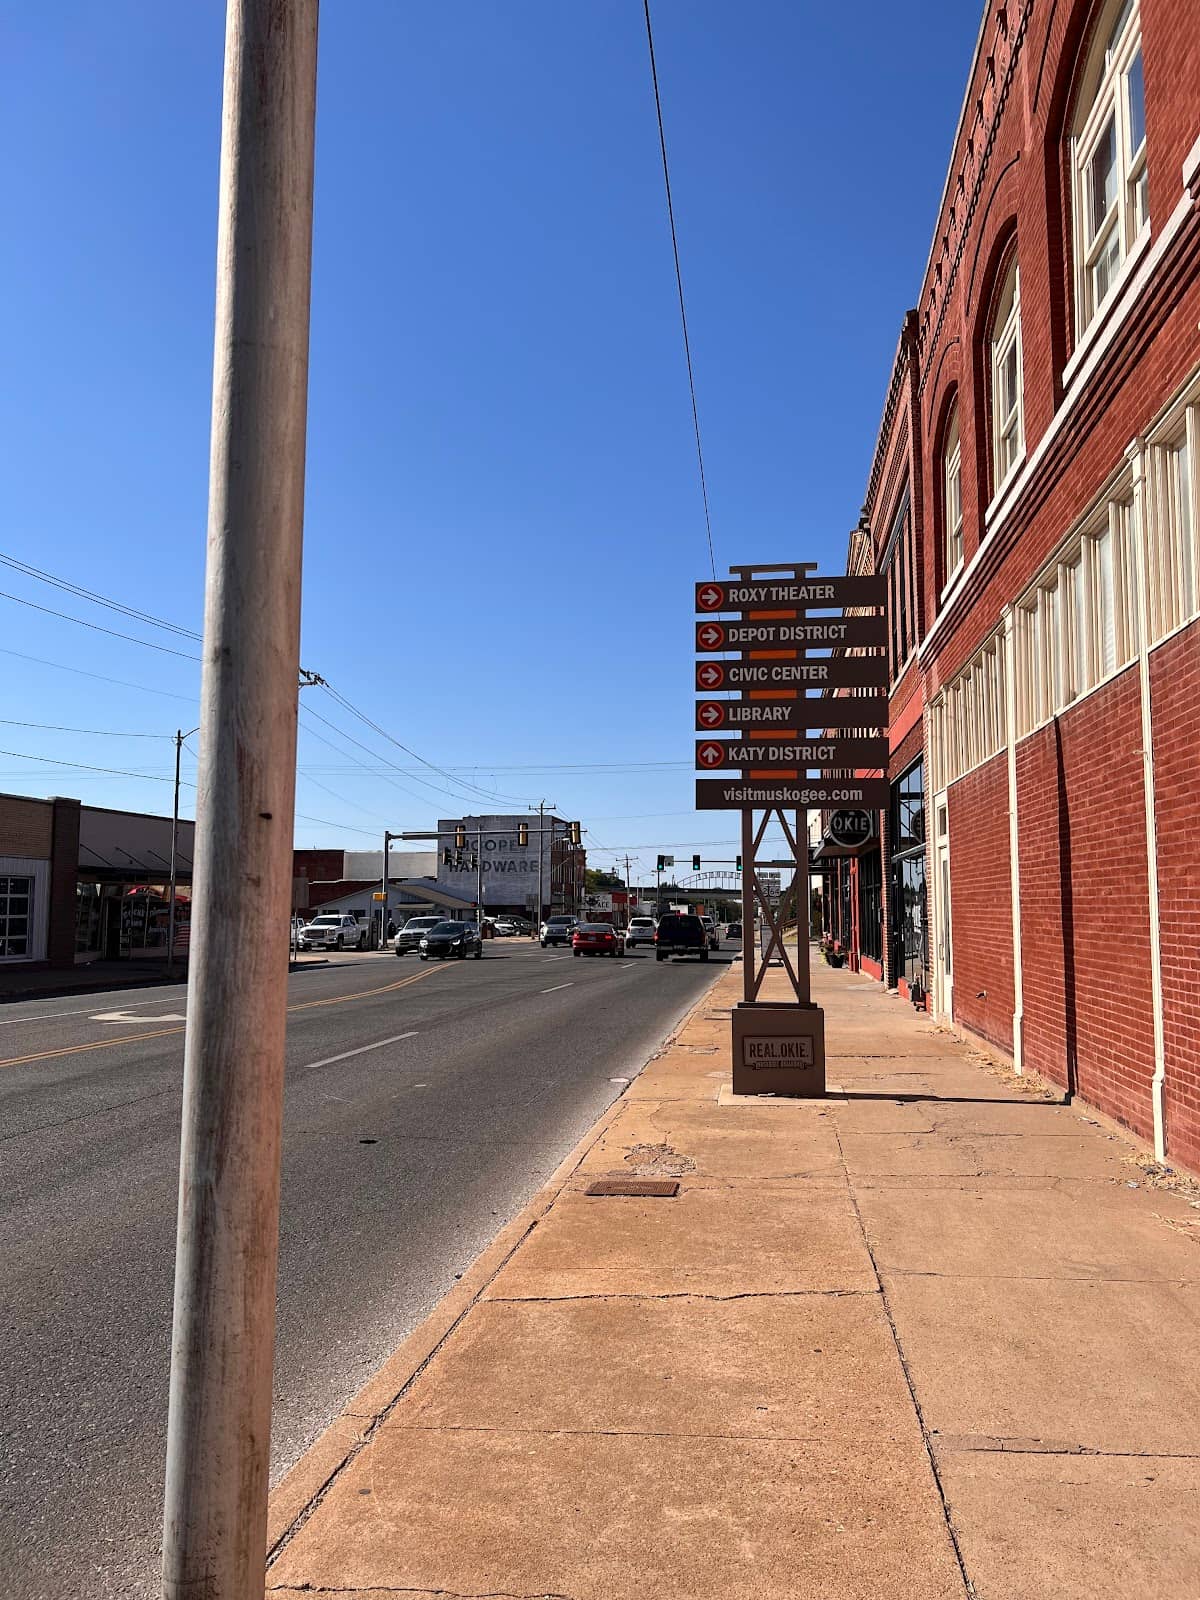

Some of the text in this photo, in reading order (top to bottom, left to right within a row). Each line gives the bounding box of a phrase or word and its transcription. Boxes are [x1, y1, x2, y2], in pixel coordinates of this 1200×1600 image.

[729, 585, 835, 602] ROXY THEATER
[729, 625, 847, 642] DEPOT DISTRICT
[729, 665, 828, 682] CIVIC CENTER
[729, 706, 792, 721] LIBRARY
[729, 746, 836, 761] KATY DISTRICT
[723, 787, 863, 804] visitmuskogee.com
[833, 816, 868, 831] OKIE
[461, 839, 526, 852] HOOPE
